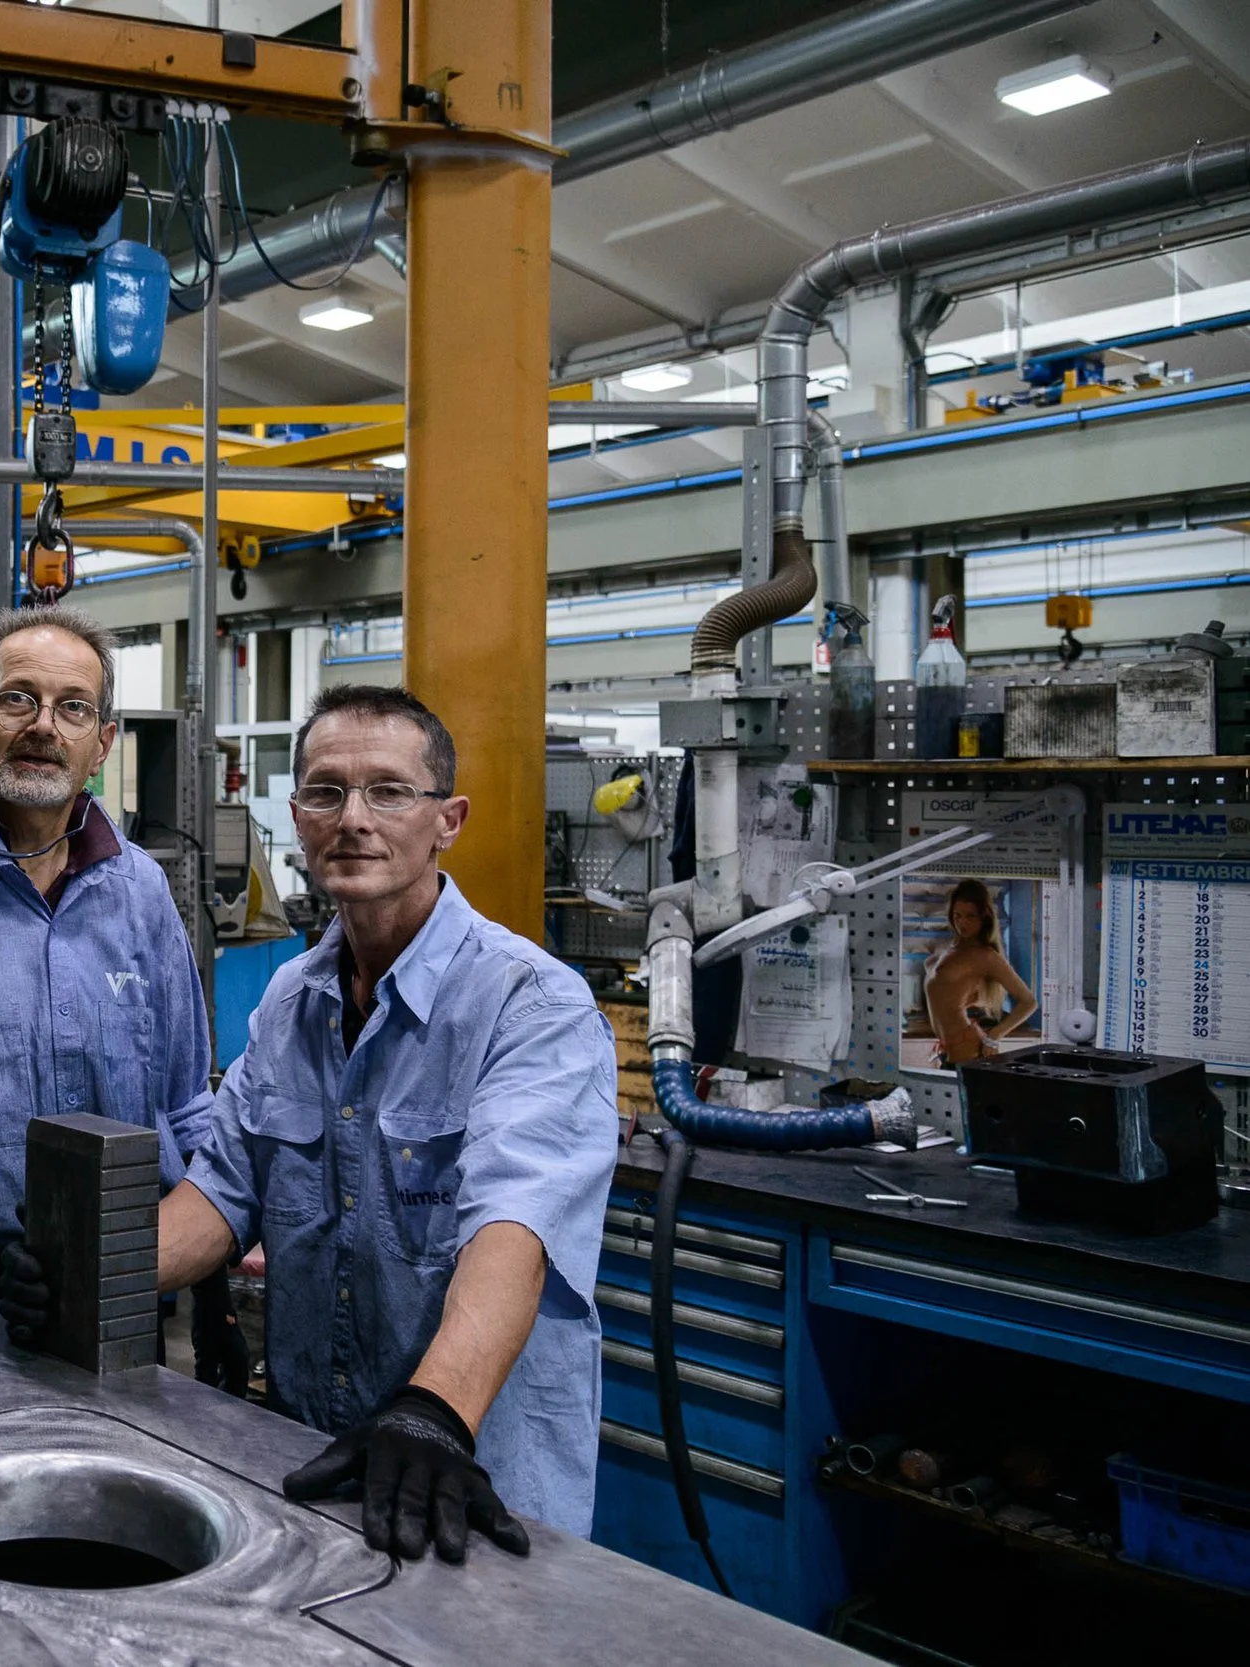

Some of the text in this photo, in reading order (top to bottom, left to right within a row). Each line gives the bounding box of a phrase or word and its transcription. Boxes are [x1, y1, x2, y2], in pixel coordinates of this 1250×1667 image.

[1139, 880, 1145, 888] 1
[1138, 891, 1146, 900] 2
[1196, 893, 1209, 902] 18
[1138, 902, 1146, 911] 3
[1196, 904, 1209, 914] 19
[1137, 912, 1146, 922] 4
[1194, 916, 1211, 925] 20
[1137, 923, 1146, 933] 5
[1194, 927, 1208, 936] 21
[1137, 934, 1146, 944] 6
[1194, 938, 1210, 948] 22
[1137, 945, 1145, 955] 7
[1194, 949, 1210, 959] 23
[1136, 956, 1145, 966] 8
[1194, 960, 1209, 970] 24
[1136, 967, 1145, 977] 9
[1194, 971, 1210, 981] 25
[1134, 978, 1148, 988] 10
[1194, 982, 1209, 992] 26
[1134, 989, 1145, 999] 11
[1194, 994, 1209, 1003] 27
[1134, 1000, 1146, 1010] 12
[1193, 1005, 1209, 1015] 28
[1134, 1011, 1146, 1021] 13
[1193, 1016, 1208, 1026] 29
[1132, 1022, 1146, 1032] 14
[1192, 1027, 1209, 1037] 30
[1132, 1033, 1145, 1043] 15
